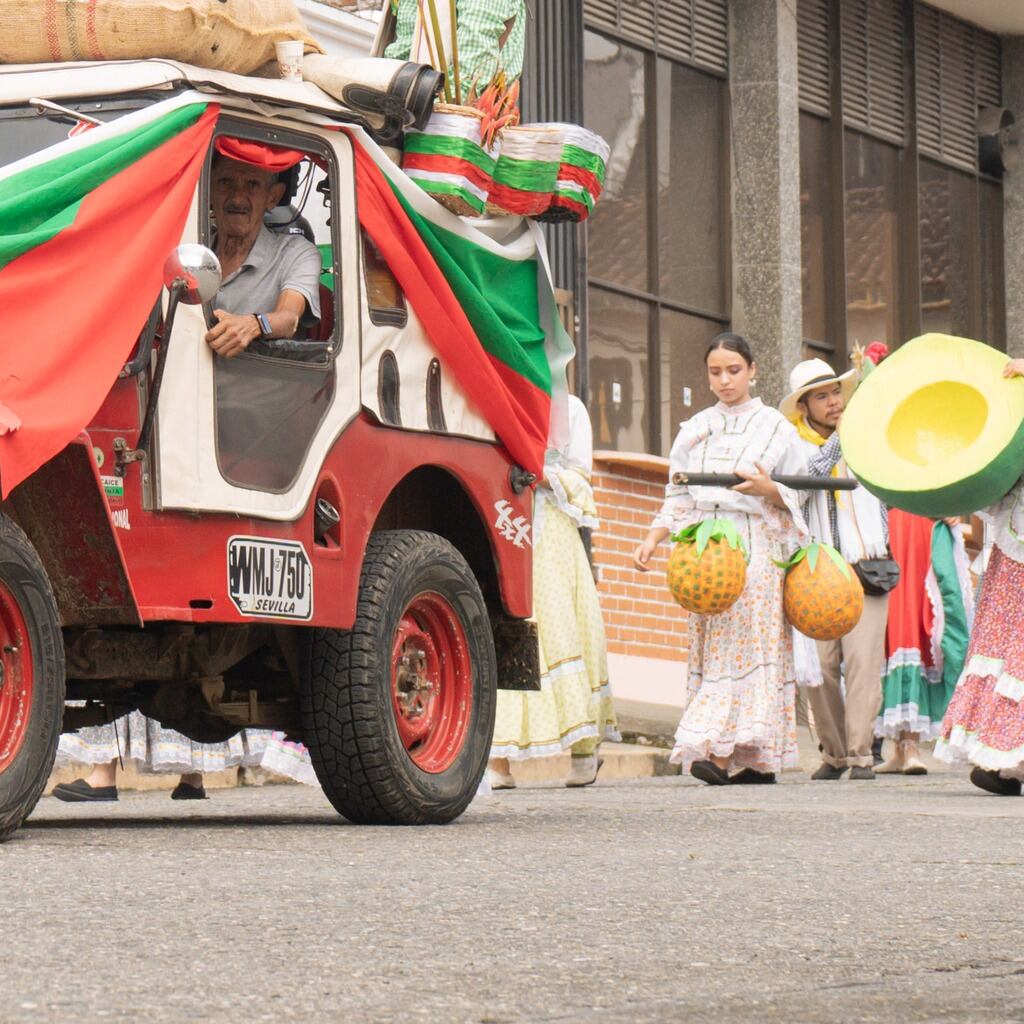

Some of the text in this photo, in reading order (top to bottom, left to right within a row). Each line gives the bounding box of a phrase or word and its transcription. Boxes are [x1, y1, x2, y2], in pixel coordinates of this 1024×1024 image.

[230, 545, 306, 600] WMJ 750
[256, 599, 296, 613] SEVILLA
